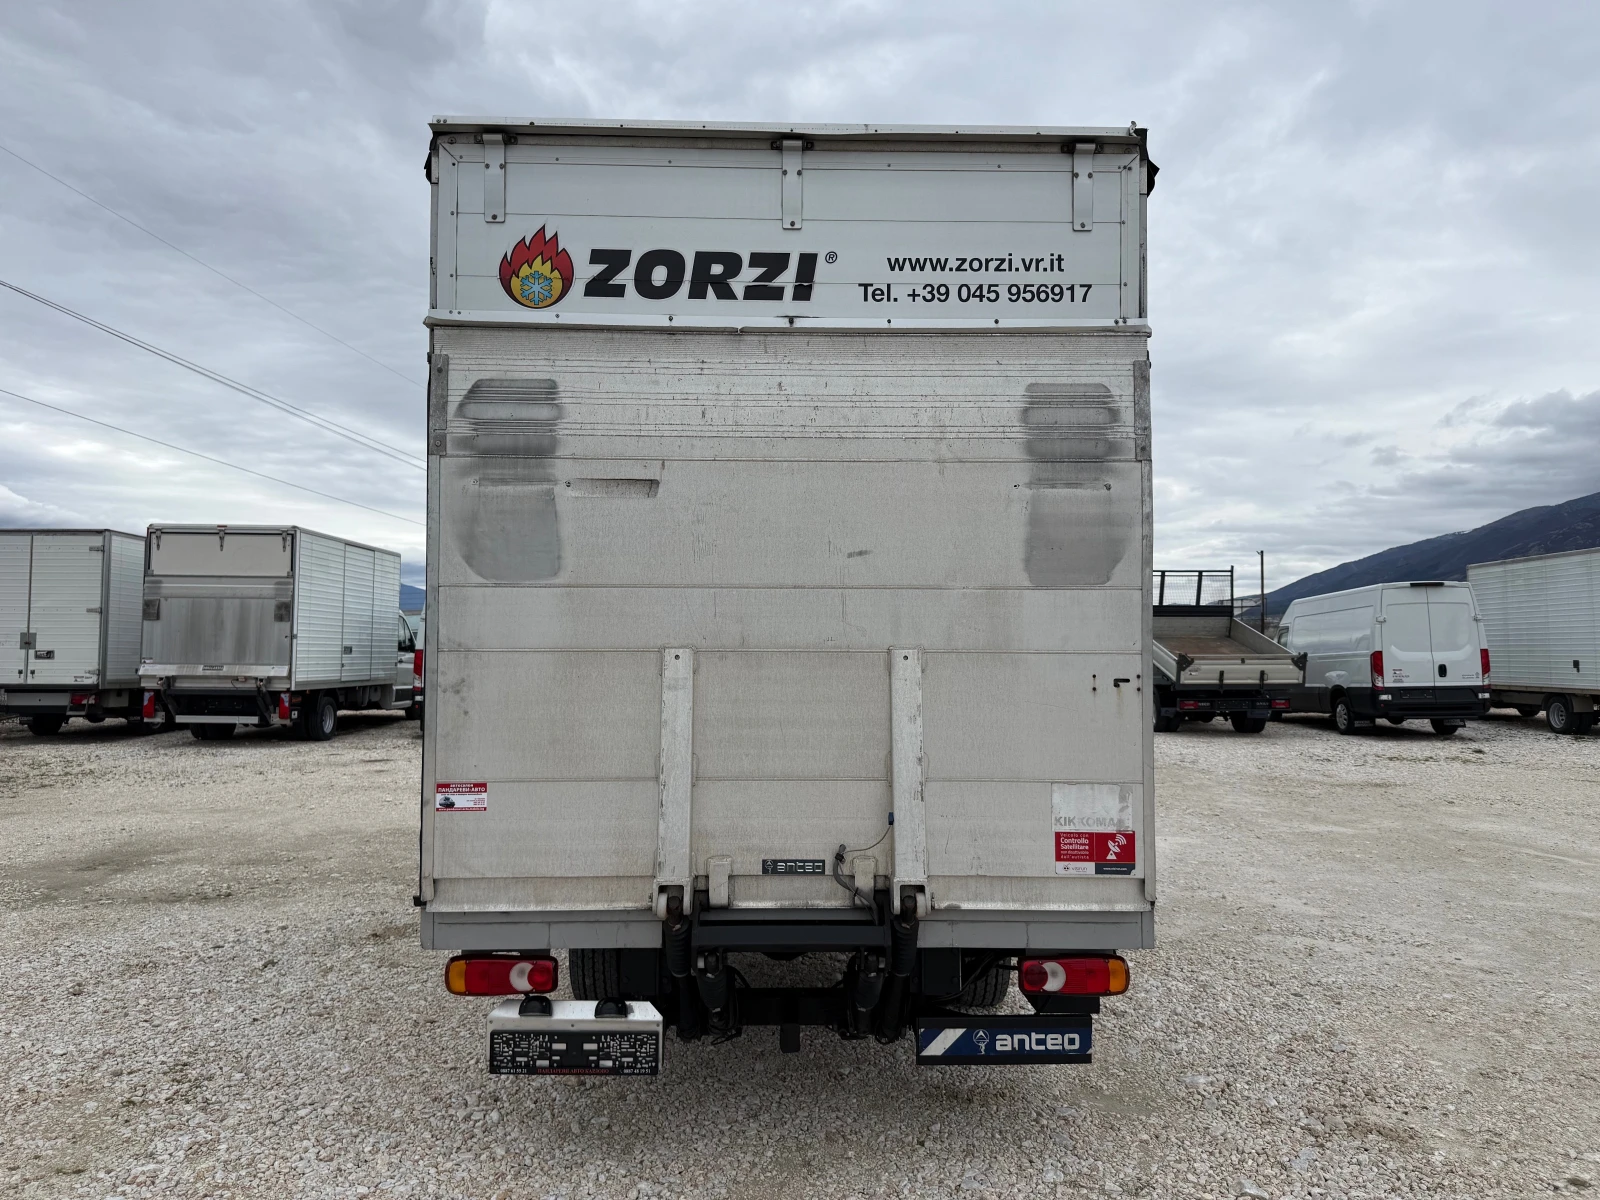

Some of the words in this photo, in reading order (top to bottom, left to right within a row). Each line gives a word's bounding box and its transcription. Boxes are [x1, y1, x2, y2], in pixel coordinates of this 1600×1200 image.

[887, 253, 1065, 273] www.zorzi.vr.it
[583, 249, 819, 302] ZORZI
[858, 283, 898, 303] Tel.
[907, 284, 950, 303] +39
[957, 284, 1000, 303] 045
[1007, 284, 1093, 303] 956917
[777, 861, 823, 872] anteo
[995, 1031, 1081, 1051] anteo
